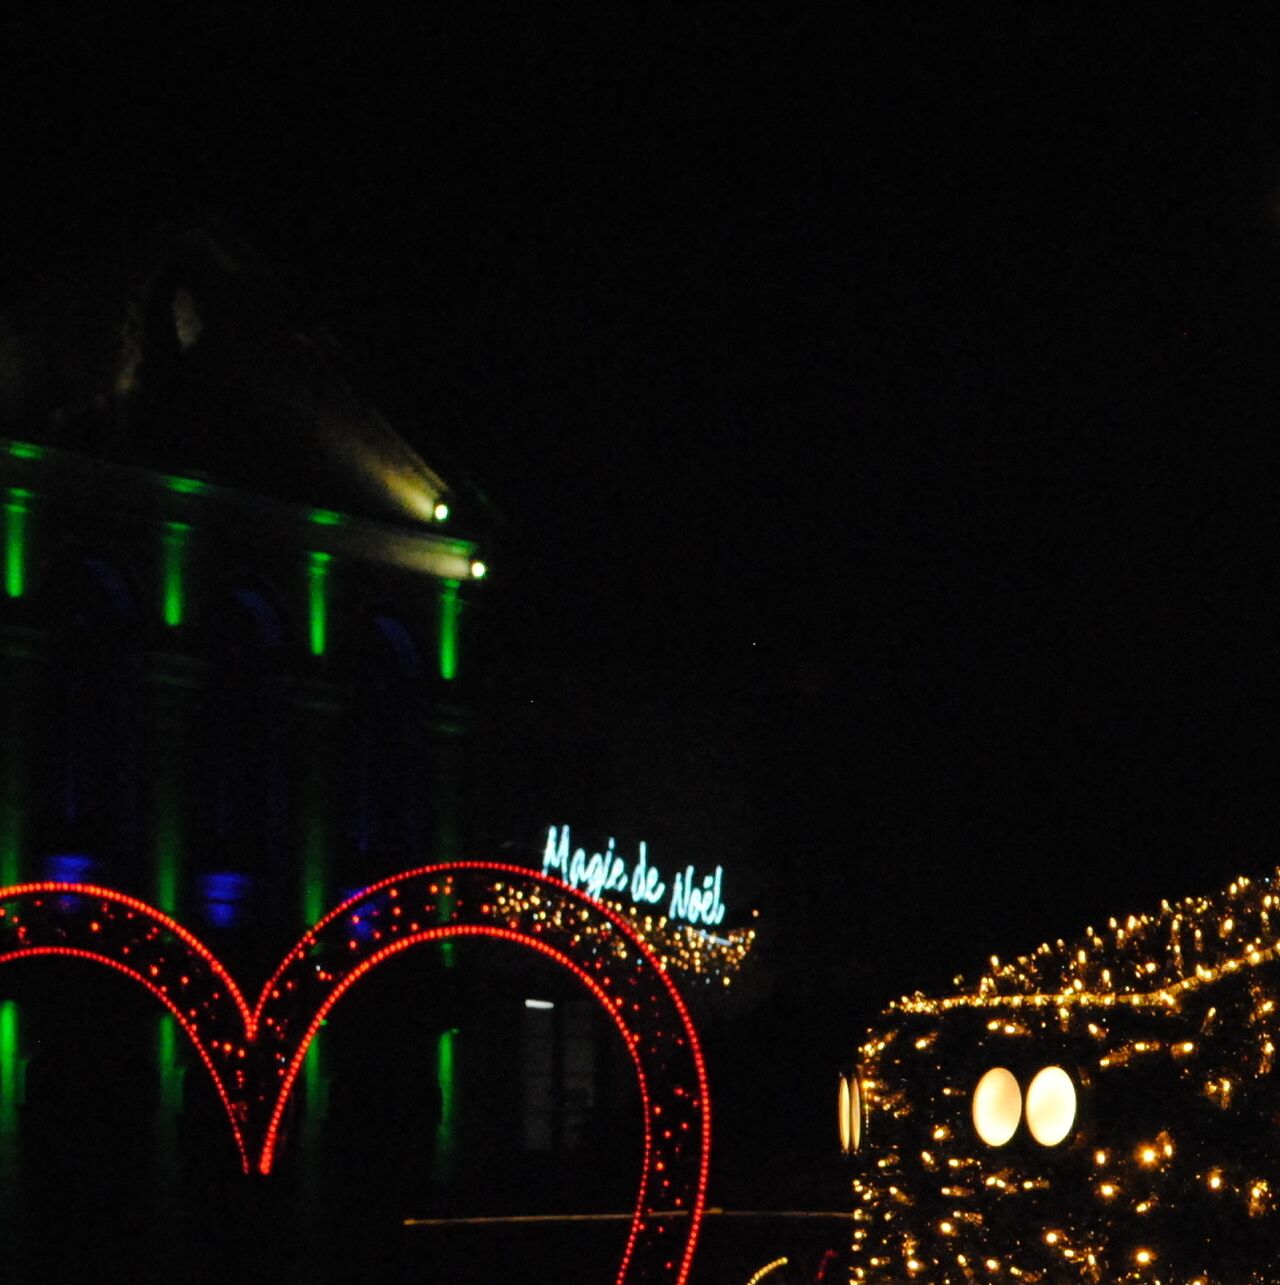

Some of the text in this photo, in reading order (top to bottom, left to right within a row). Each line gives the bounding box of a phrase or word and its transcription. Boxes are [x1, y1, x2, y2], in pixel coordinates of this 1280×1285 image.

[542, 824, 725, 924] Magie de Noël
